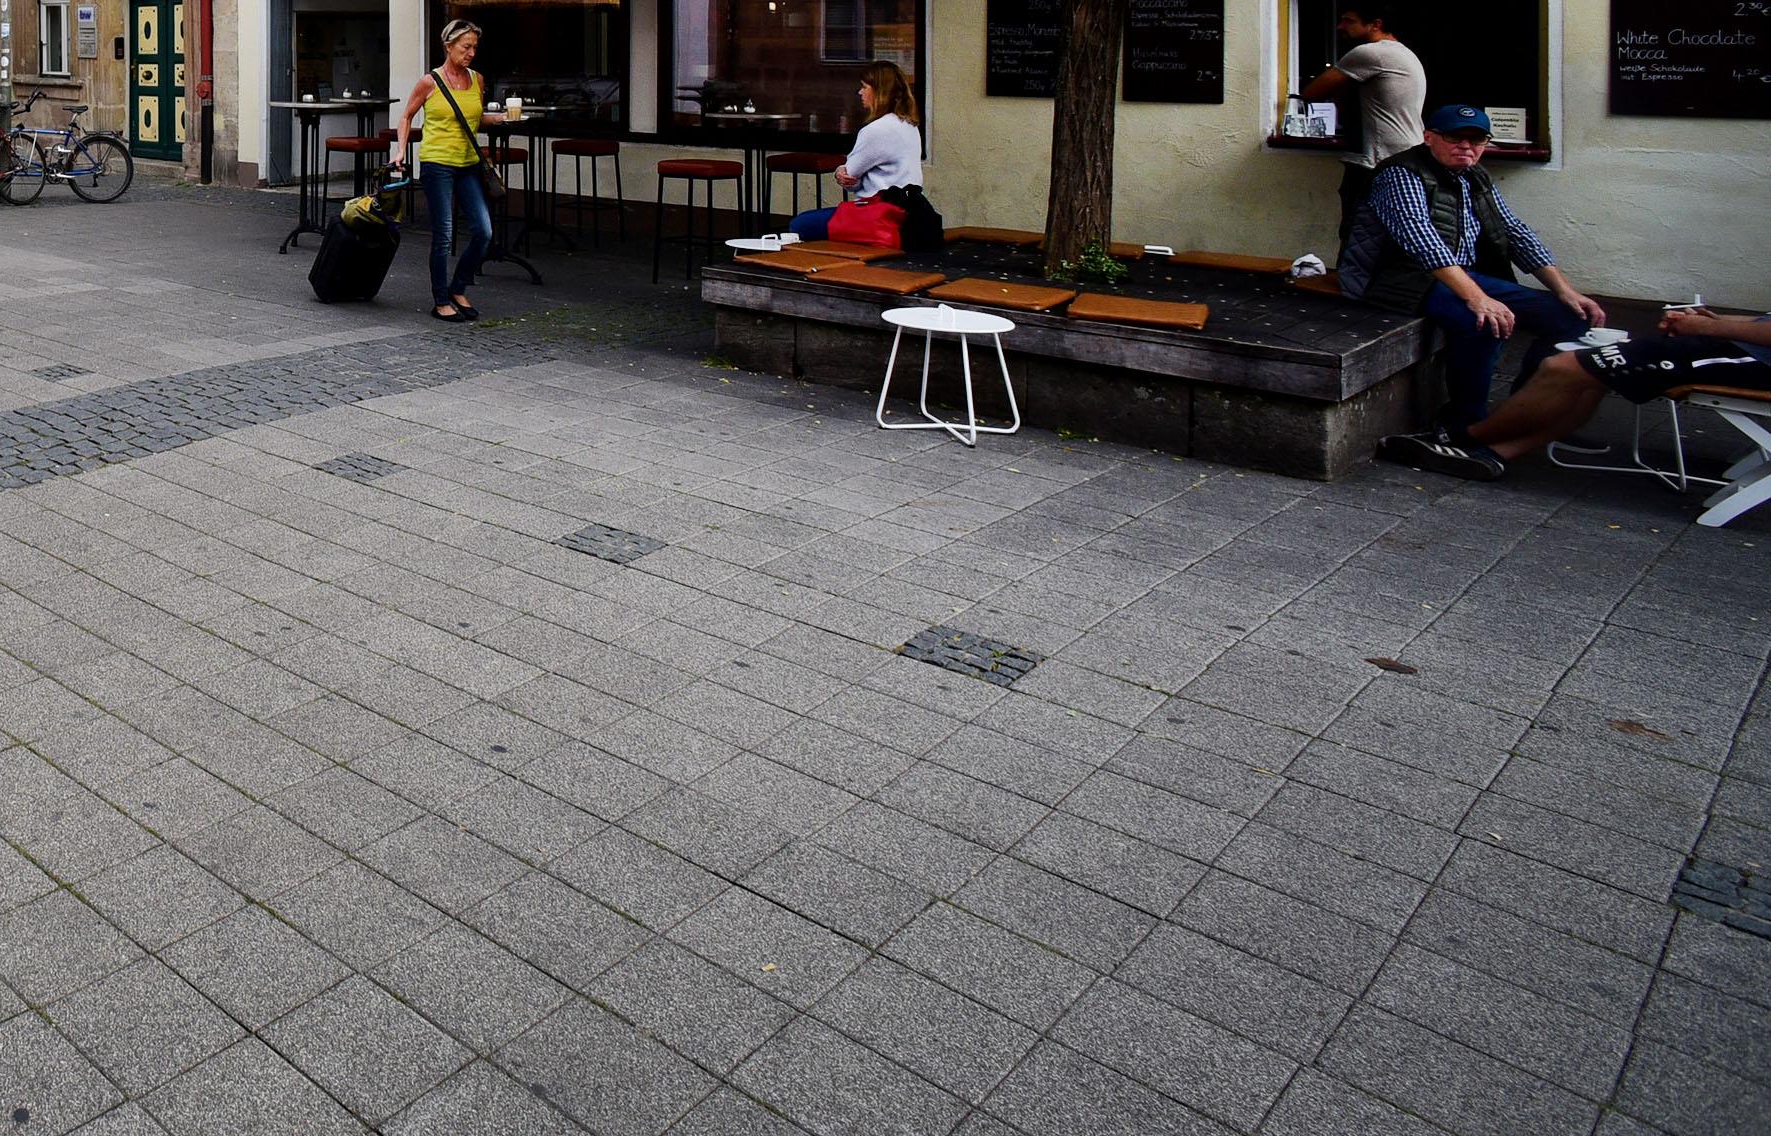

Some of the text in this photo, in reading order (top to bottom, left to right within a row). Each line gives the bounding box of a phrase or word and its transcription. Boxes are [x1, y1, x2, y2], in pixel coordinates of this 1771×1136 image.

[1617, 28, 1756, 46] White Chocolate
[1618, 47, 1668, 60] Mocca
[1641, 73, 1684, 83] Espresso
